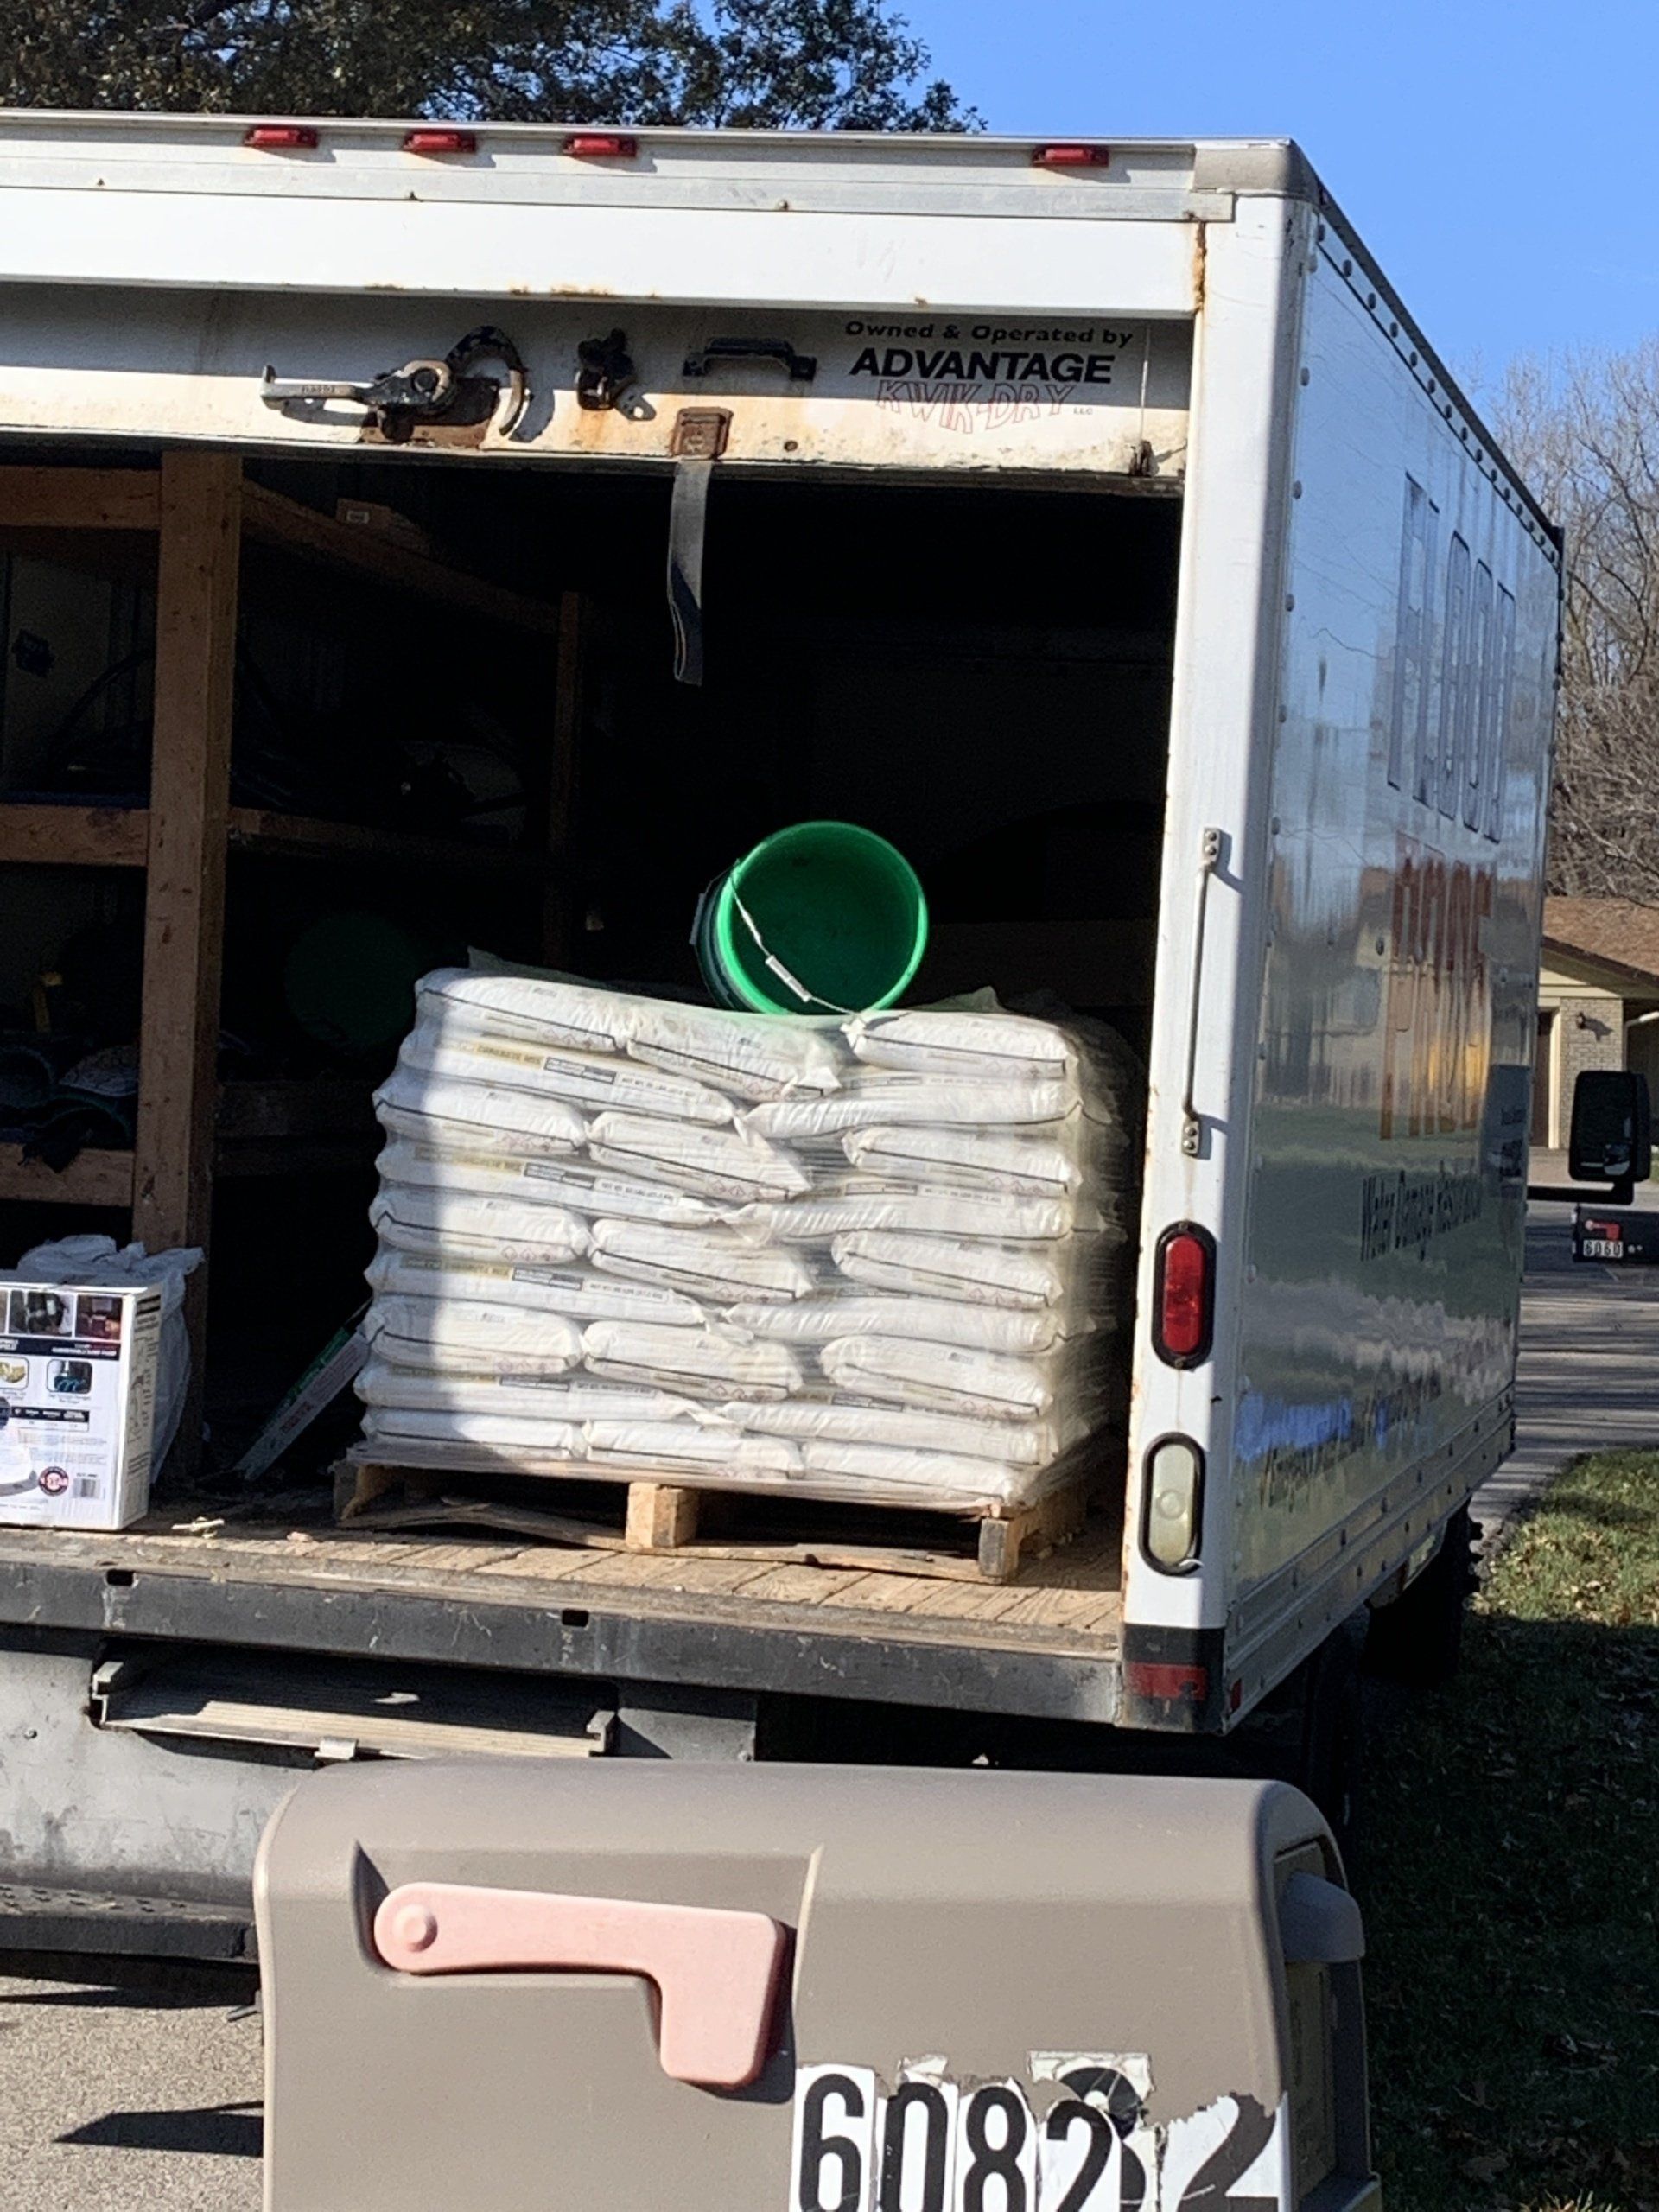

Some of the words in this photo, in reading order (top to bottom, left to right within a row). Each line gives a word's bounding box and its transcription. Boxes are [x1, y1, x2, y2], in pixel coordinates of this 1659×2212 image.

[844, 321, 933, 340] Owned
[943, 325, 961, 340] &
[971, 325, 1094, 345] Operated
[1102, 328, 1134, 348] by
[849, 347, 1116, 384] ADVANTAGE
[876, 379, 1077, 434] KWIK-DRY
